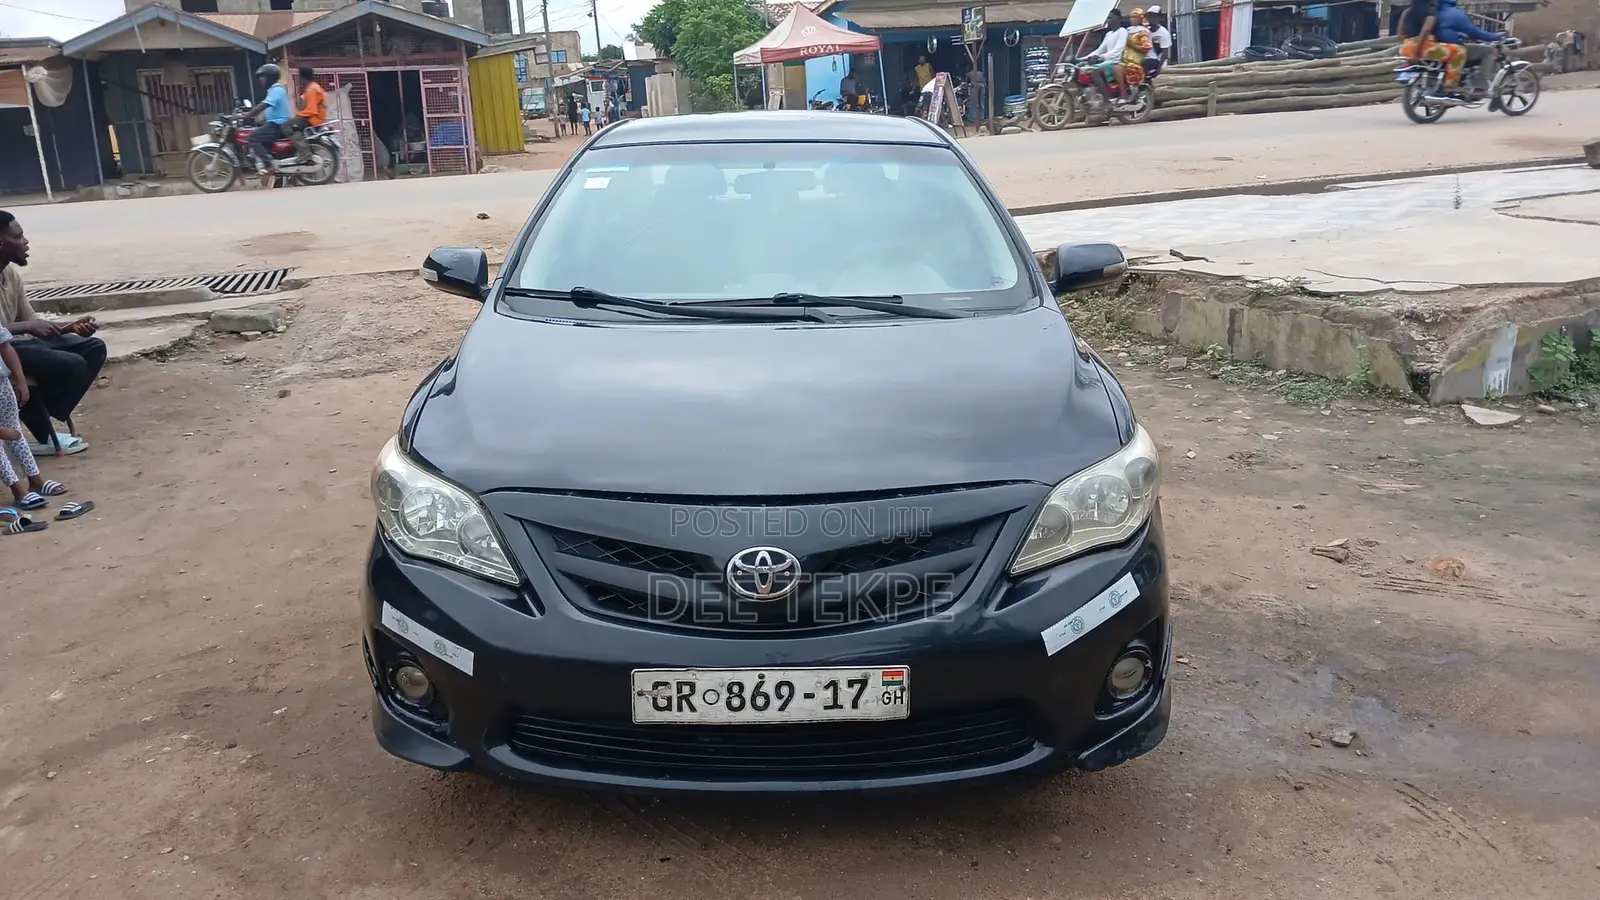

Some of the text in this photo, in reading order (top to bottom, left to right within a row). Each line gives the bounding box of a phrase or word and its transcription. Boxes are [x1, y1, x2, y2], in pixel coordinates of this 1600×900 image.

[800, 44, 844, 56] ROYAL
[651, 681, 698, 713] GR
[881, 690, 904, 705] GH
